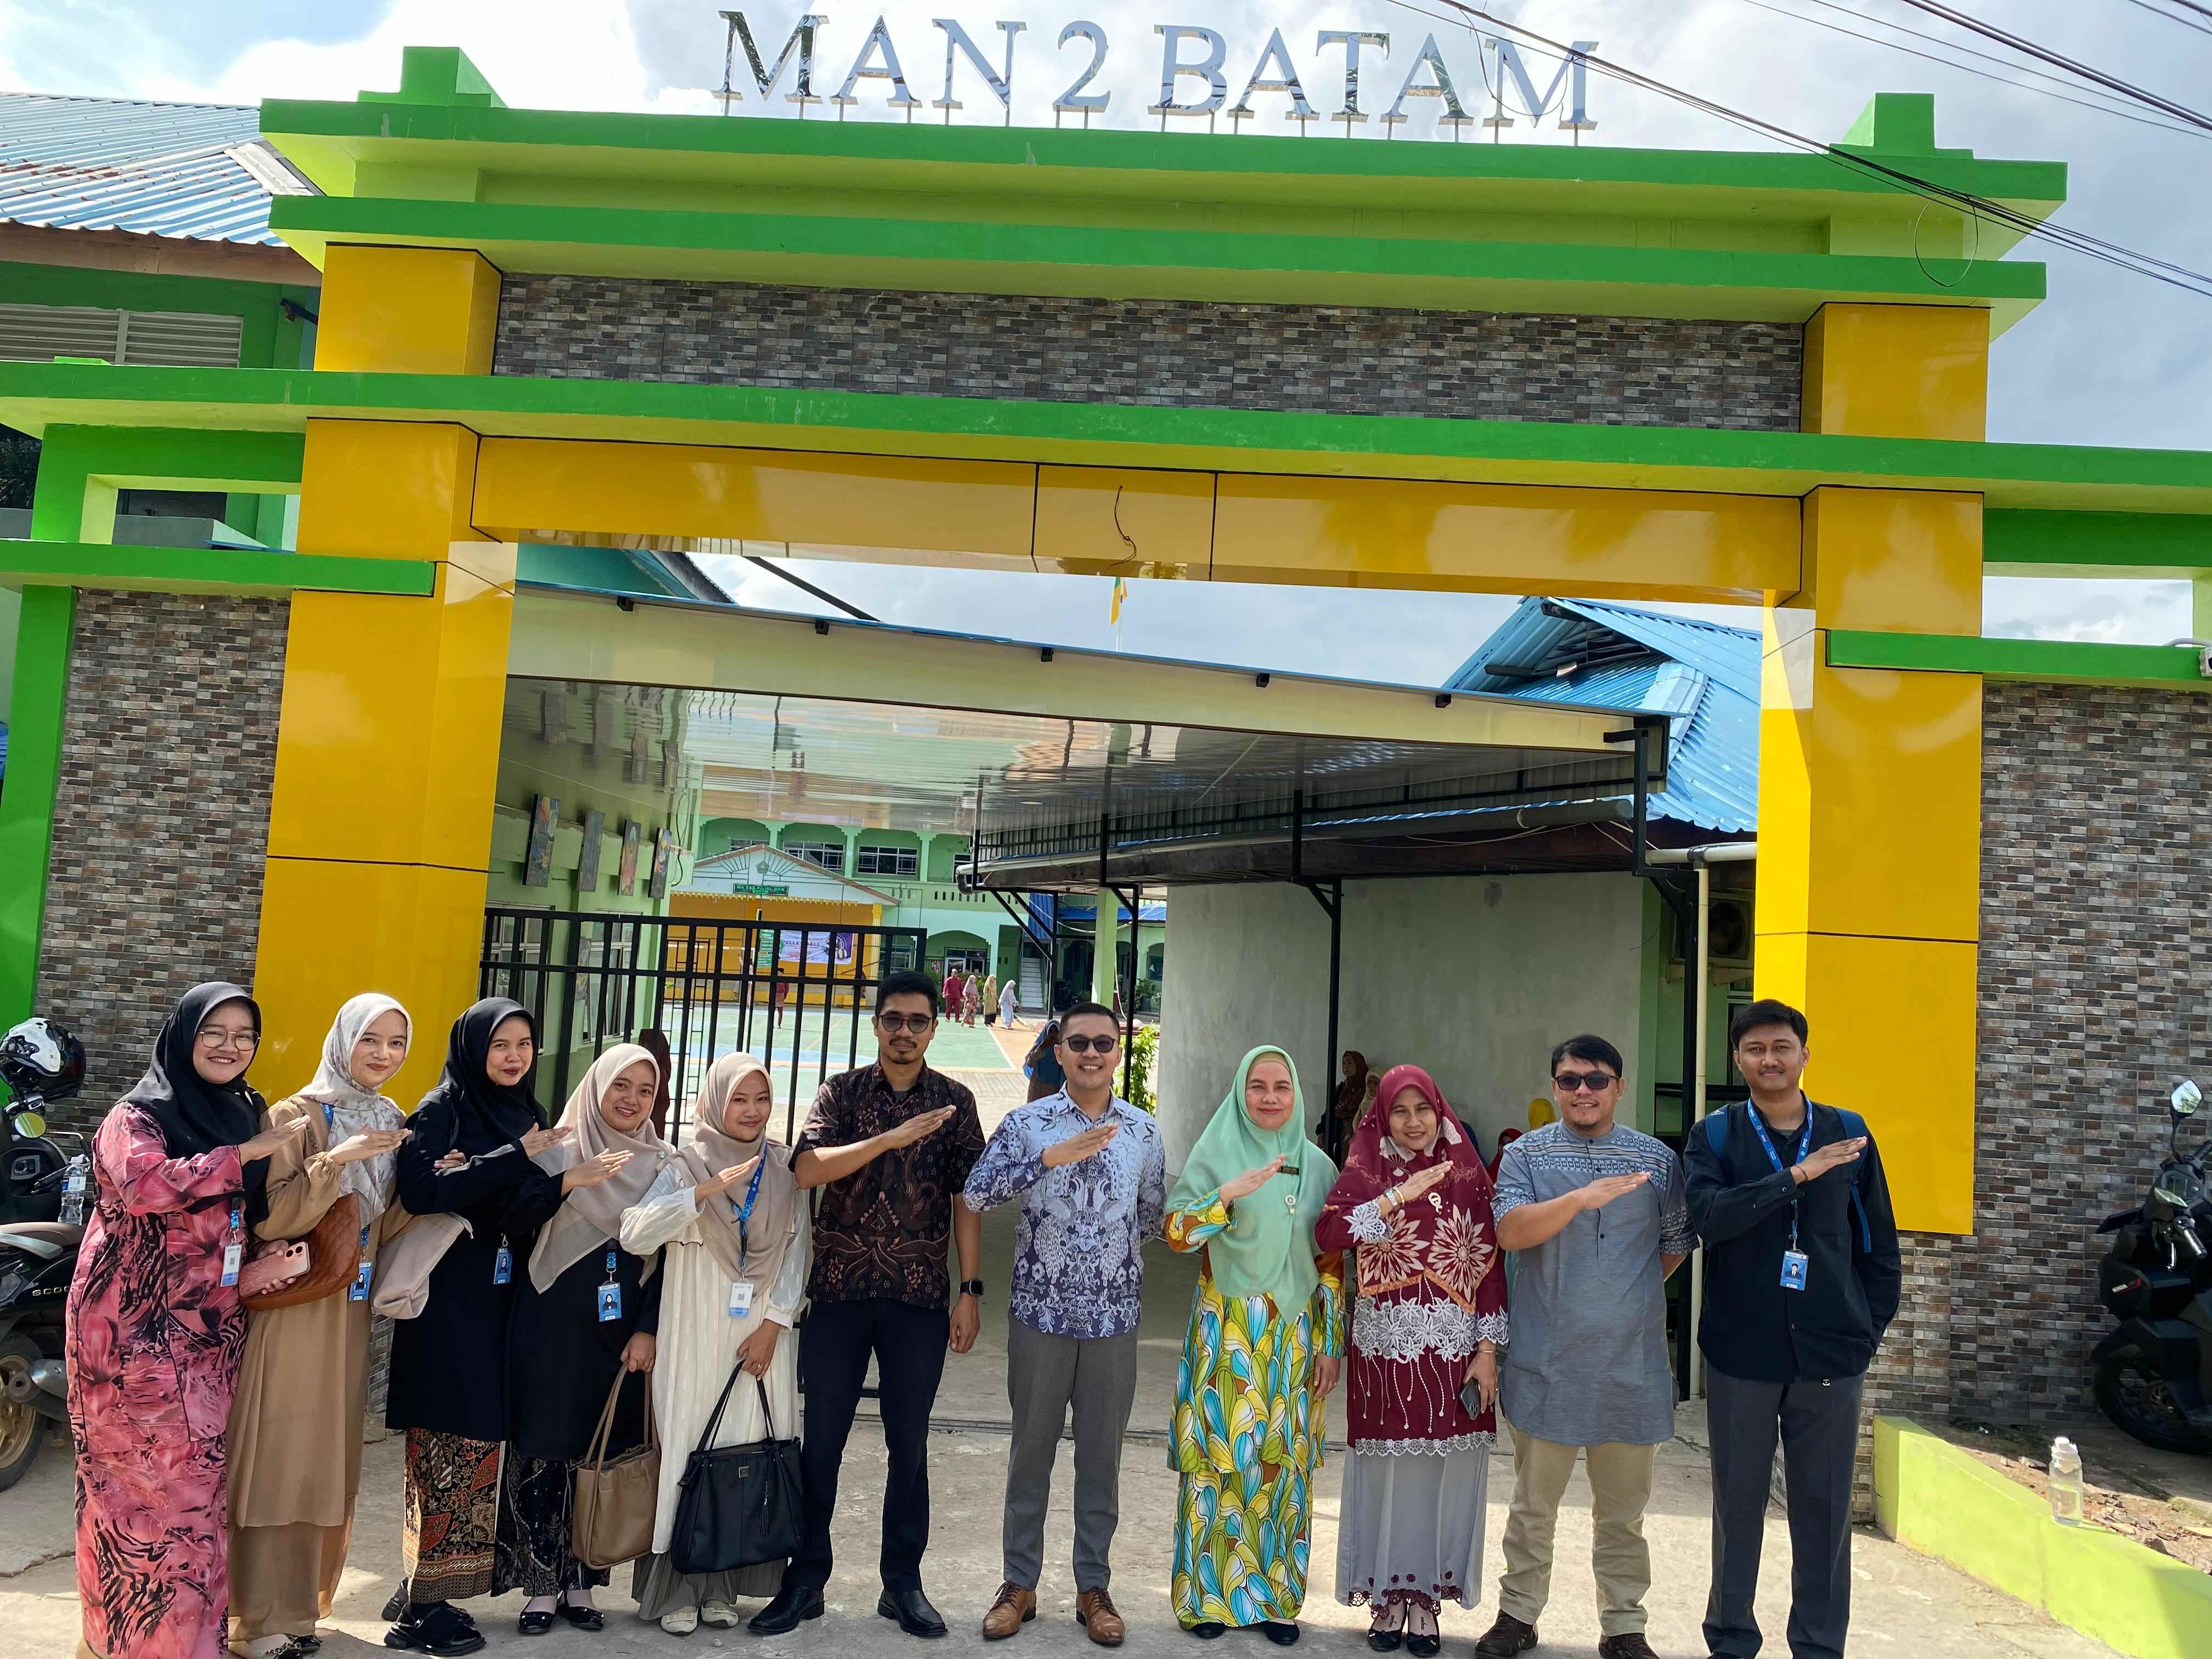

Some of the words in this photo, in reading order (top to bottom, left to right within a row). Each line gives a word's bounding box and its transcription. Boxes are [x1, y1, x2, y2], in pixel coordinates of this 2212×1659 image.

[712, 10, 1028, 110] MAN
[1052, 20, 1111, 113] 2
[1147, 24, 1600, 131] BATAM
